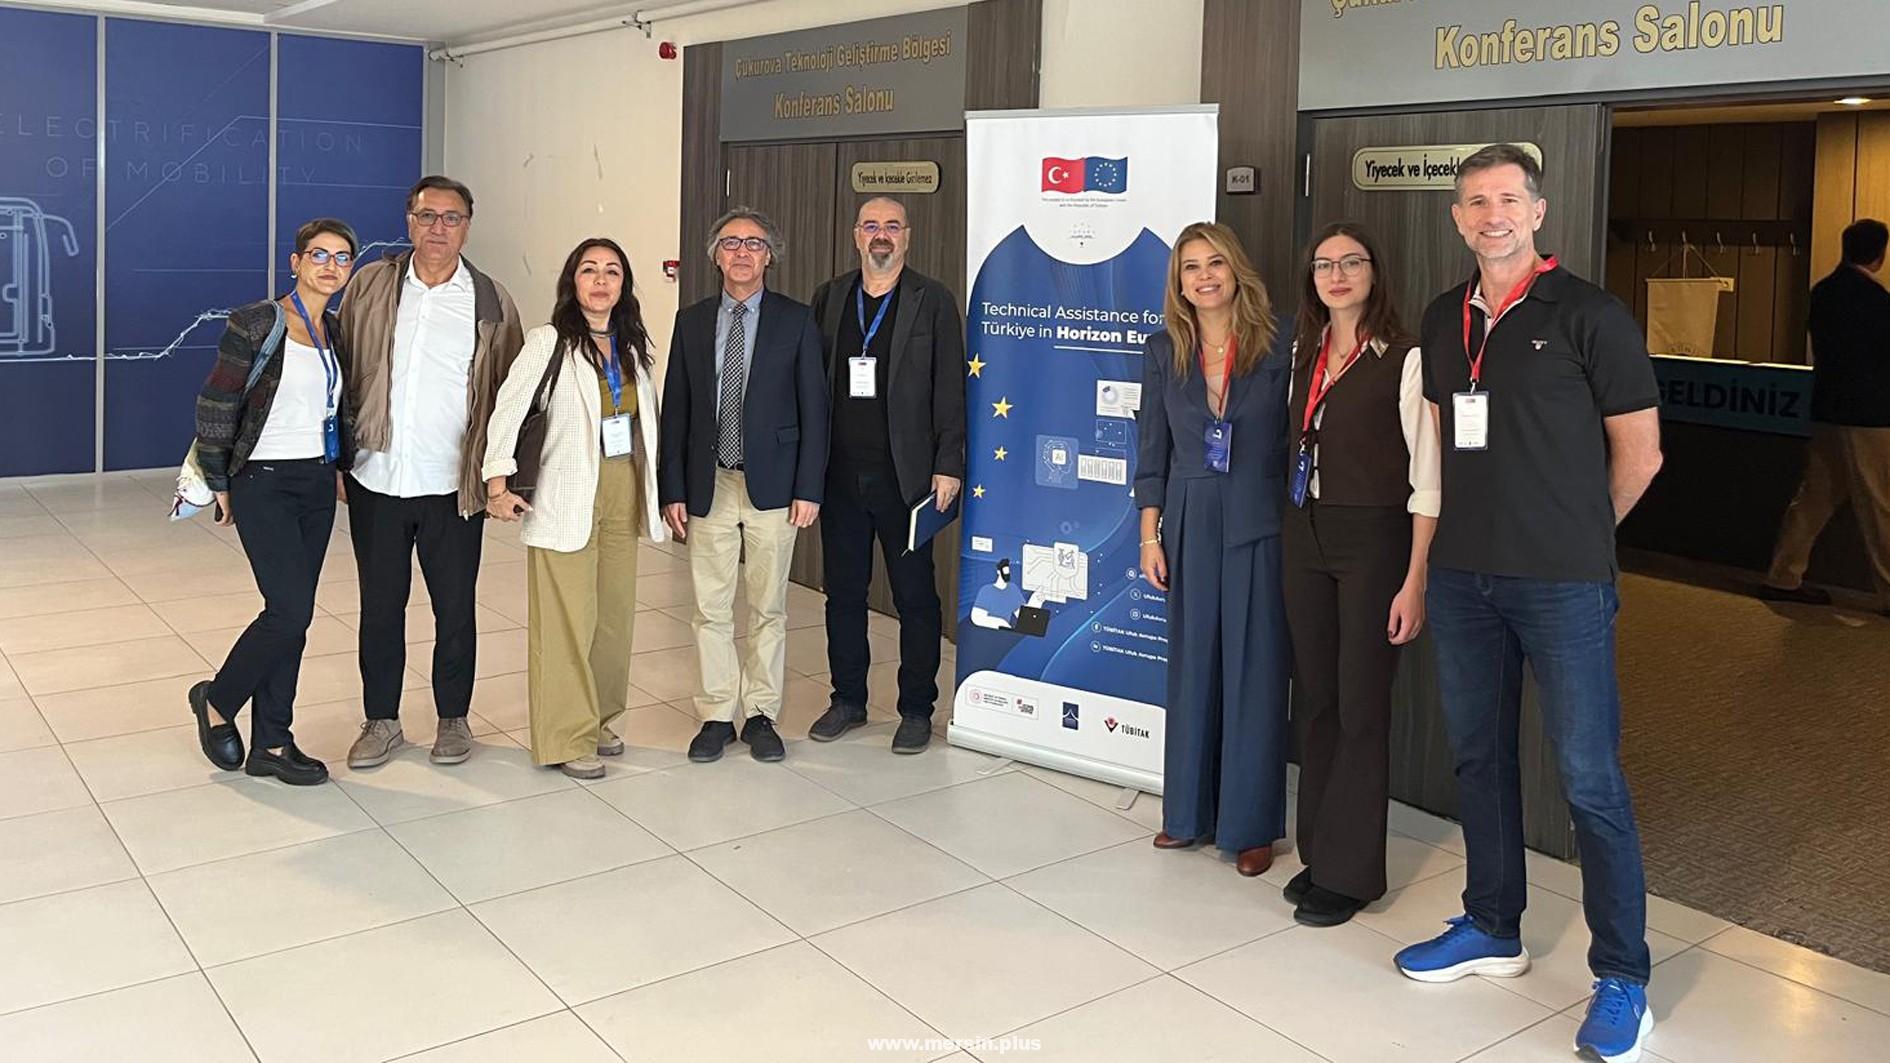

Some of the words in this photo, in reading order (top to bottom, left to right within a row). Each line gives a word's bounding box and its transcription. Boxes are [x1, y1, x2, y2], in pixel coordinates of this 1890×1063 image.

[1435, 19, 1620, 69] Konferans
[1632, 5, 1784, 53] Salonu
[735, 58, 782, 80] Çukurova
[784, 48, 834, 73] Teknoloji
[836, 40, 898, 71] Geliştirme
[902, 31, 951, 64] Bölgesi
[773, 93, 841, 120] Konferans
[845, 84, 894, 114] Salonu
[0, 113, 362, 152] LECTRIFICATION
[46, 156, 97, 178] OF
[126, 161, 316, 186] MOBILITY
[1365, 158, 1405, 182] Yiyecek
[1407, 165, 1420, 177] ve
[1423, 154, 1460, 181] İçecekl
[981, 302, 1051, 319] Technical
[1055, 305, 1139, 323] Assistance
[1143, 310, 1165, 325] for
[981, 321, 1036, 340] Türkiye
[1039, 324, 1053, 338] in
[1056, 325, 1122, 343] Horizon
[1127, 330, 1151, 344] Eu
[1121, 724, 1149, 739] TÜBİTAK
